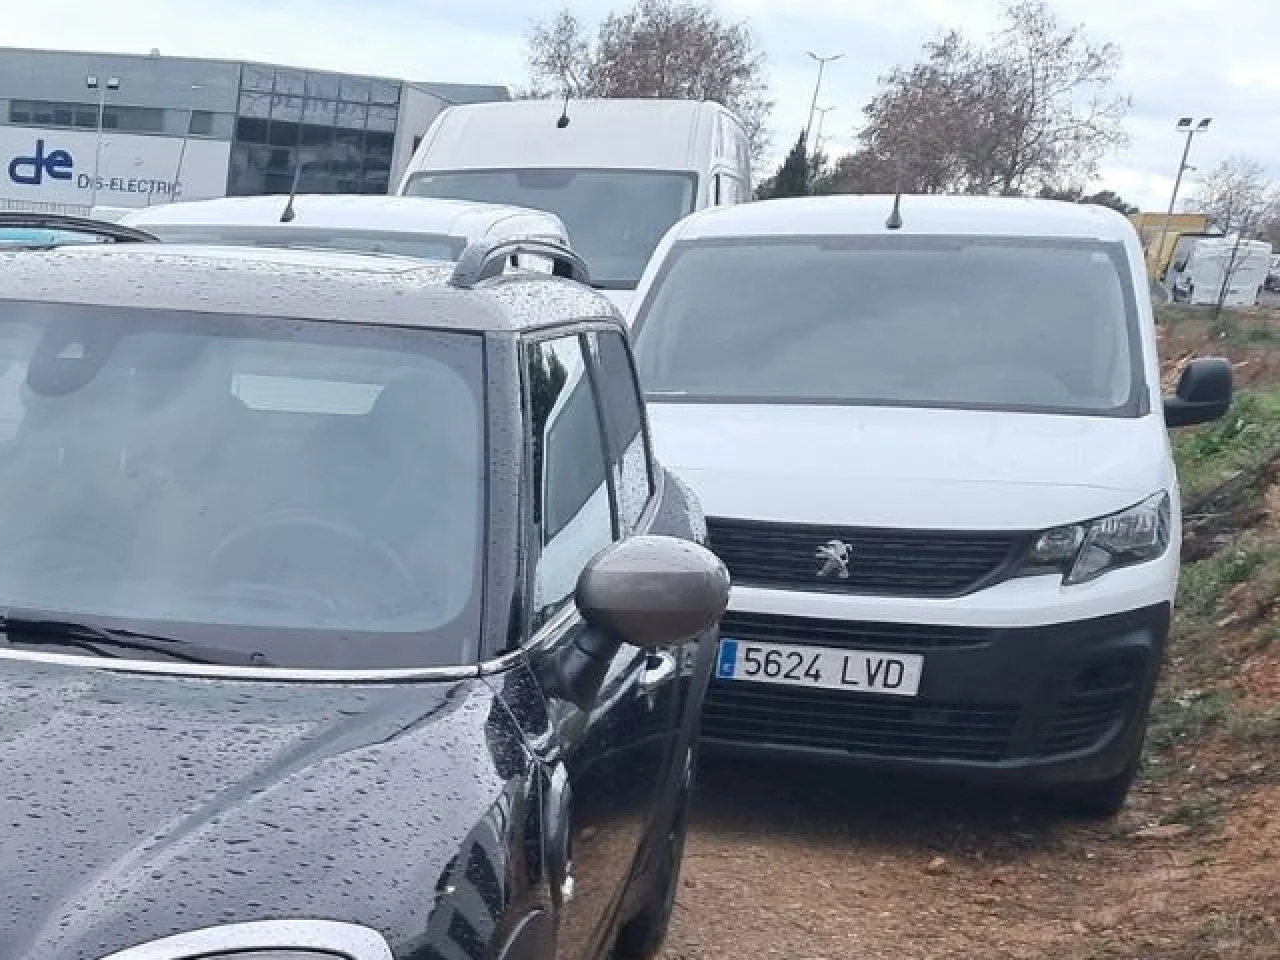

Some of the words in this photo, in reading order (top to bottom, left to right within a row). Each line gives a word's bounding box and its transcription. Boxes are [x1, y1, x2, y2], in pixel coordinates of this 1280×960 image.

[8, 140, 74, 185] de
[744, 647, 822, 682] 5624
[841, 655, 905, 689] LVD
